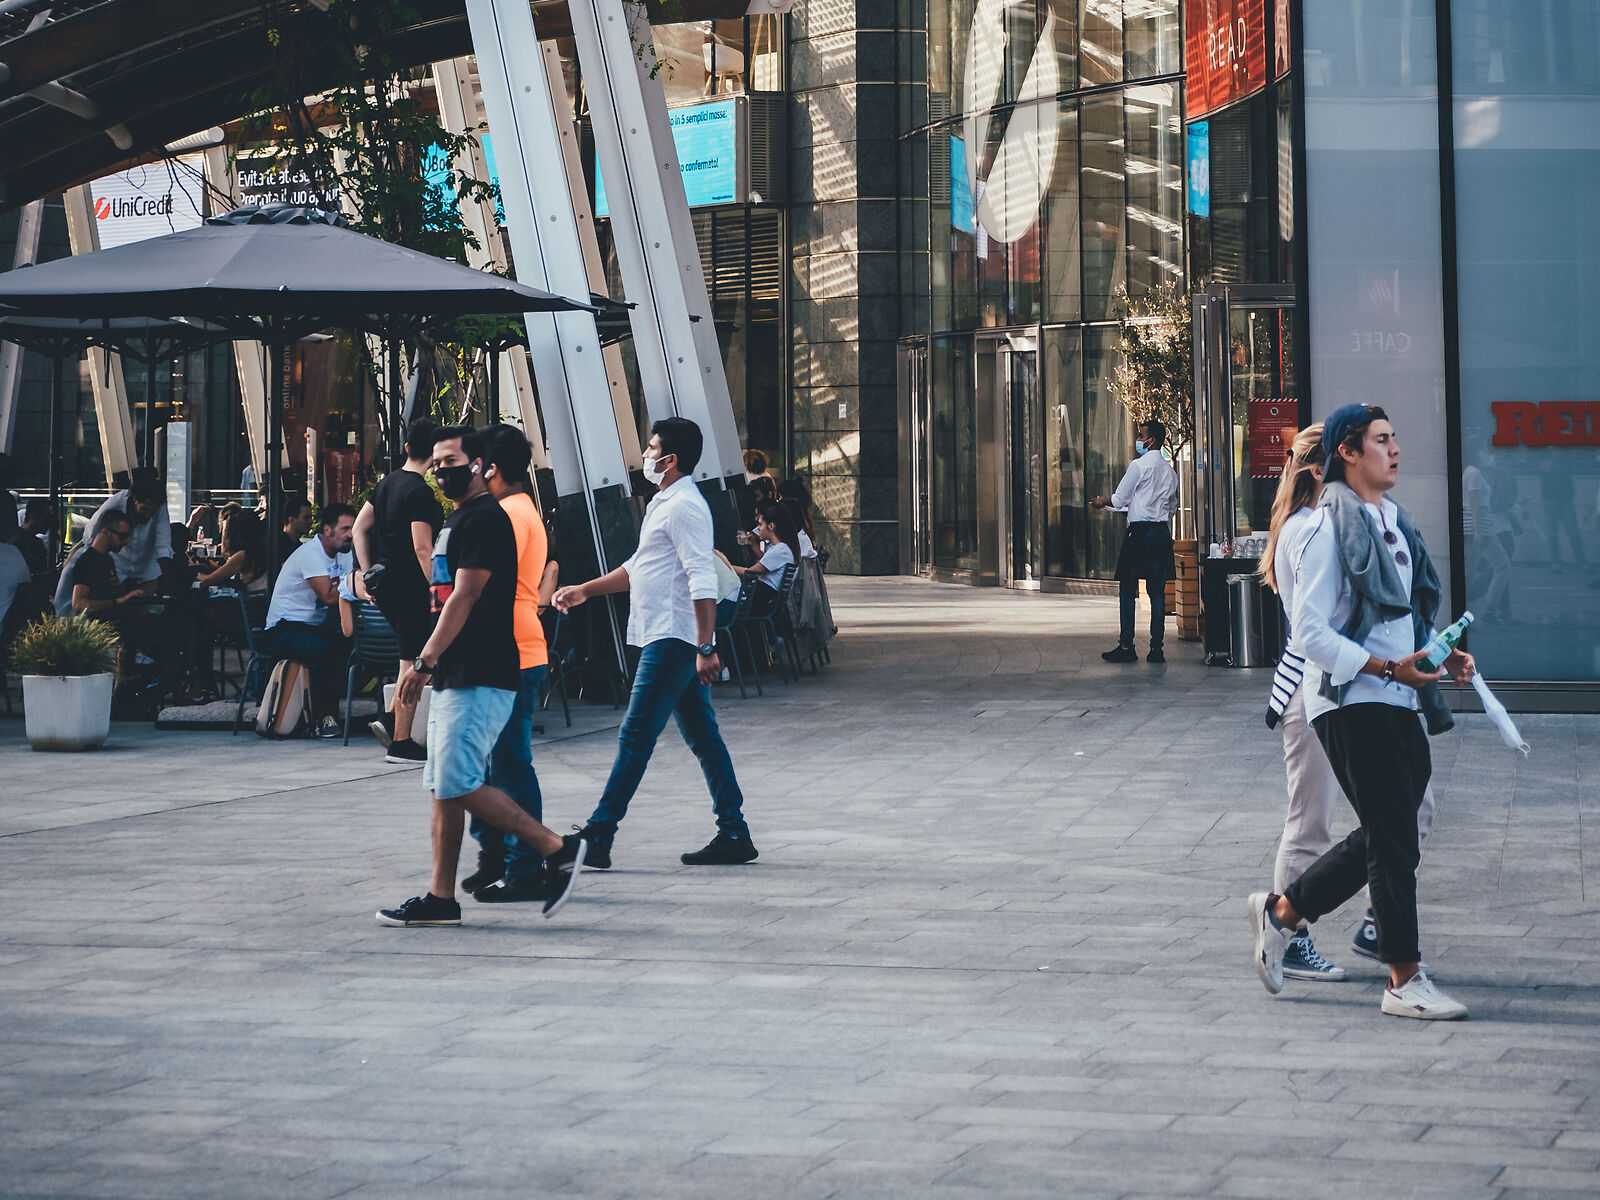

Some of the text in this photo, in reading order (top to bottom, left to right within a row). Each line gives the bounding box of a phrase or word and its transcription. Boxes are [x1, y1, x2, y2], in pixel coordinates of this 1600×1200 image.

[1209, 17, 1247, 70] READ
[238, 169, 264, 188] Evita
[112, 194, 173, 218] UniCredit
[282, 374, 291, 409] online
